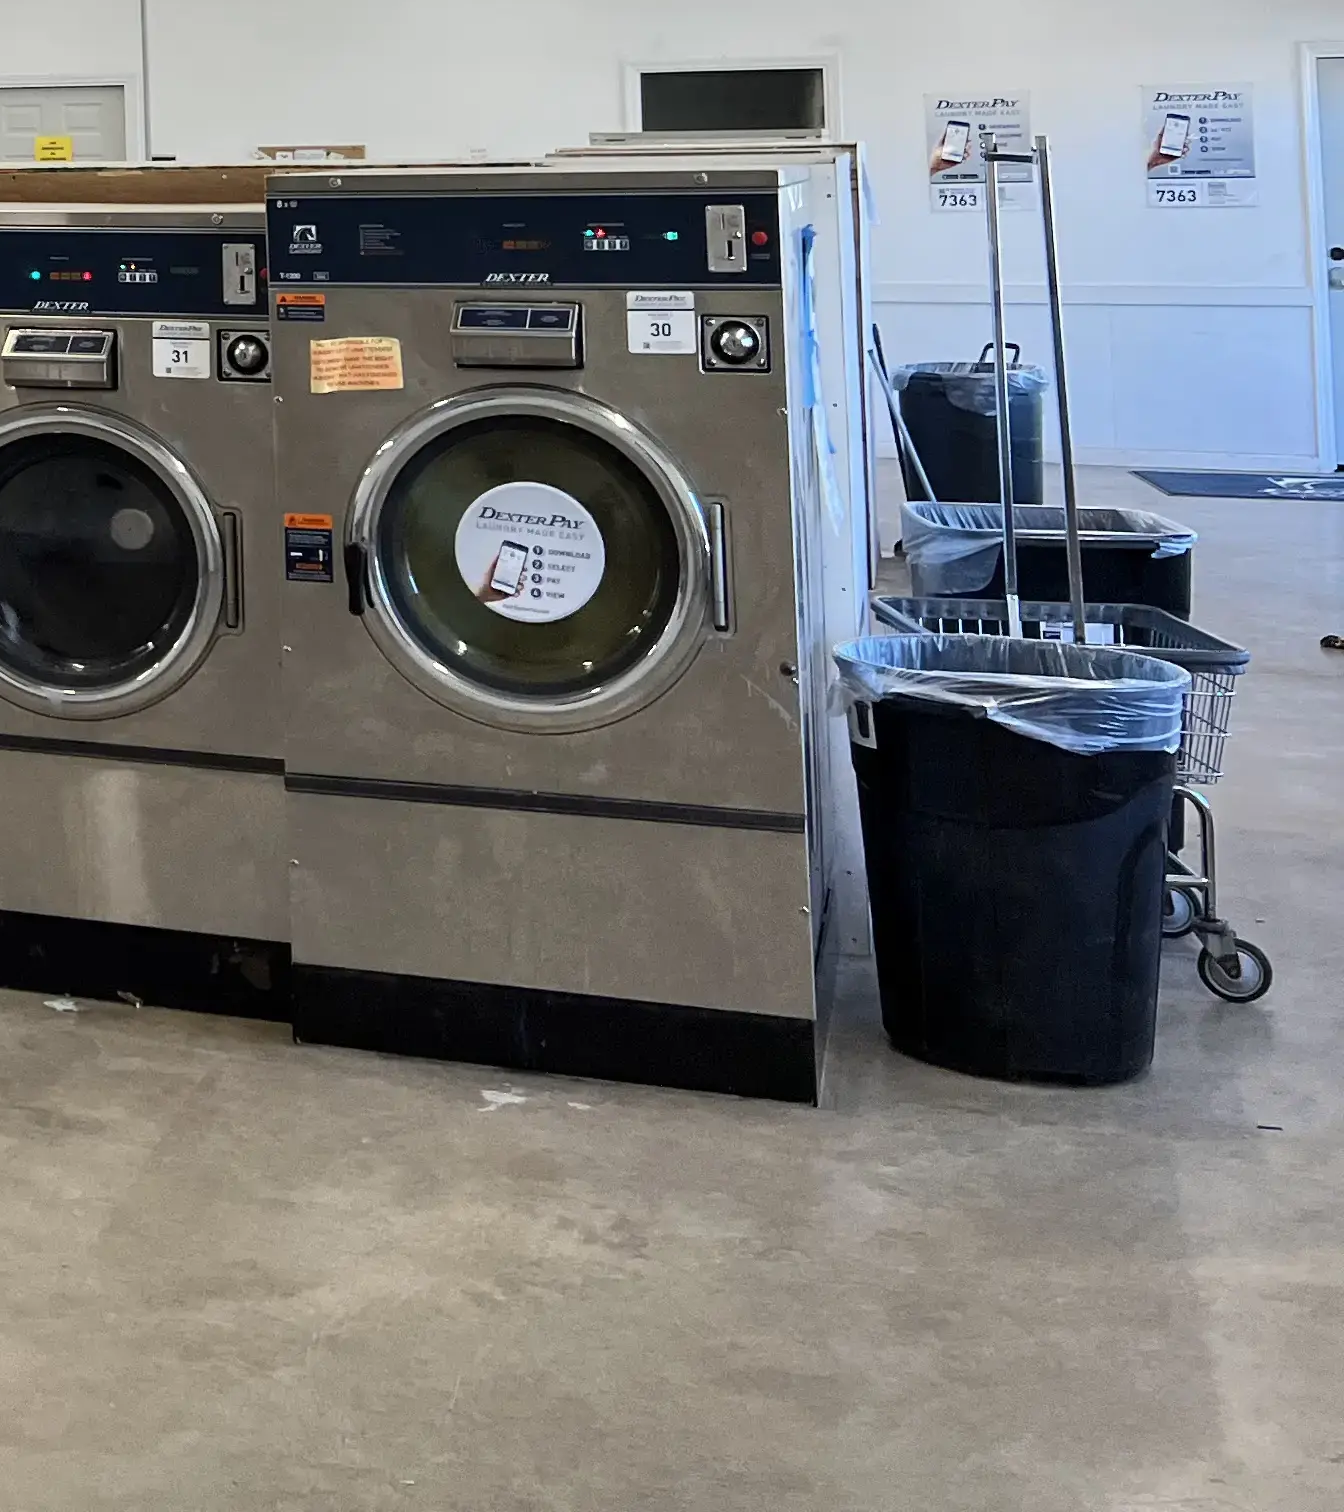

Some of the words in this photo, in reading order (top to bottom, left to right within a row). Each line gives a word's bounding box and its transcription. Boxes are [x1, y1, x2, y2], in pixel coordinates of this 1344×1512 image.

[939, 194, 977, 206] 7363
[1156, 190, 1197, 202] 7363
[486, 273, 550, 282] DEXTER
[34, 301, 89, 310] DEXTER
[650, 323, 671, 337] 30
[172, 350, 188, 363] 31
